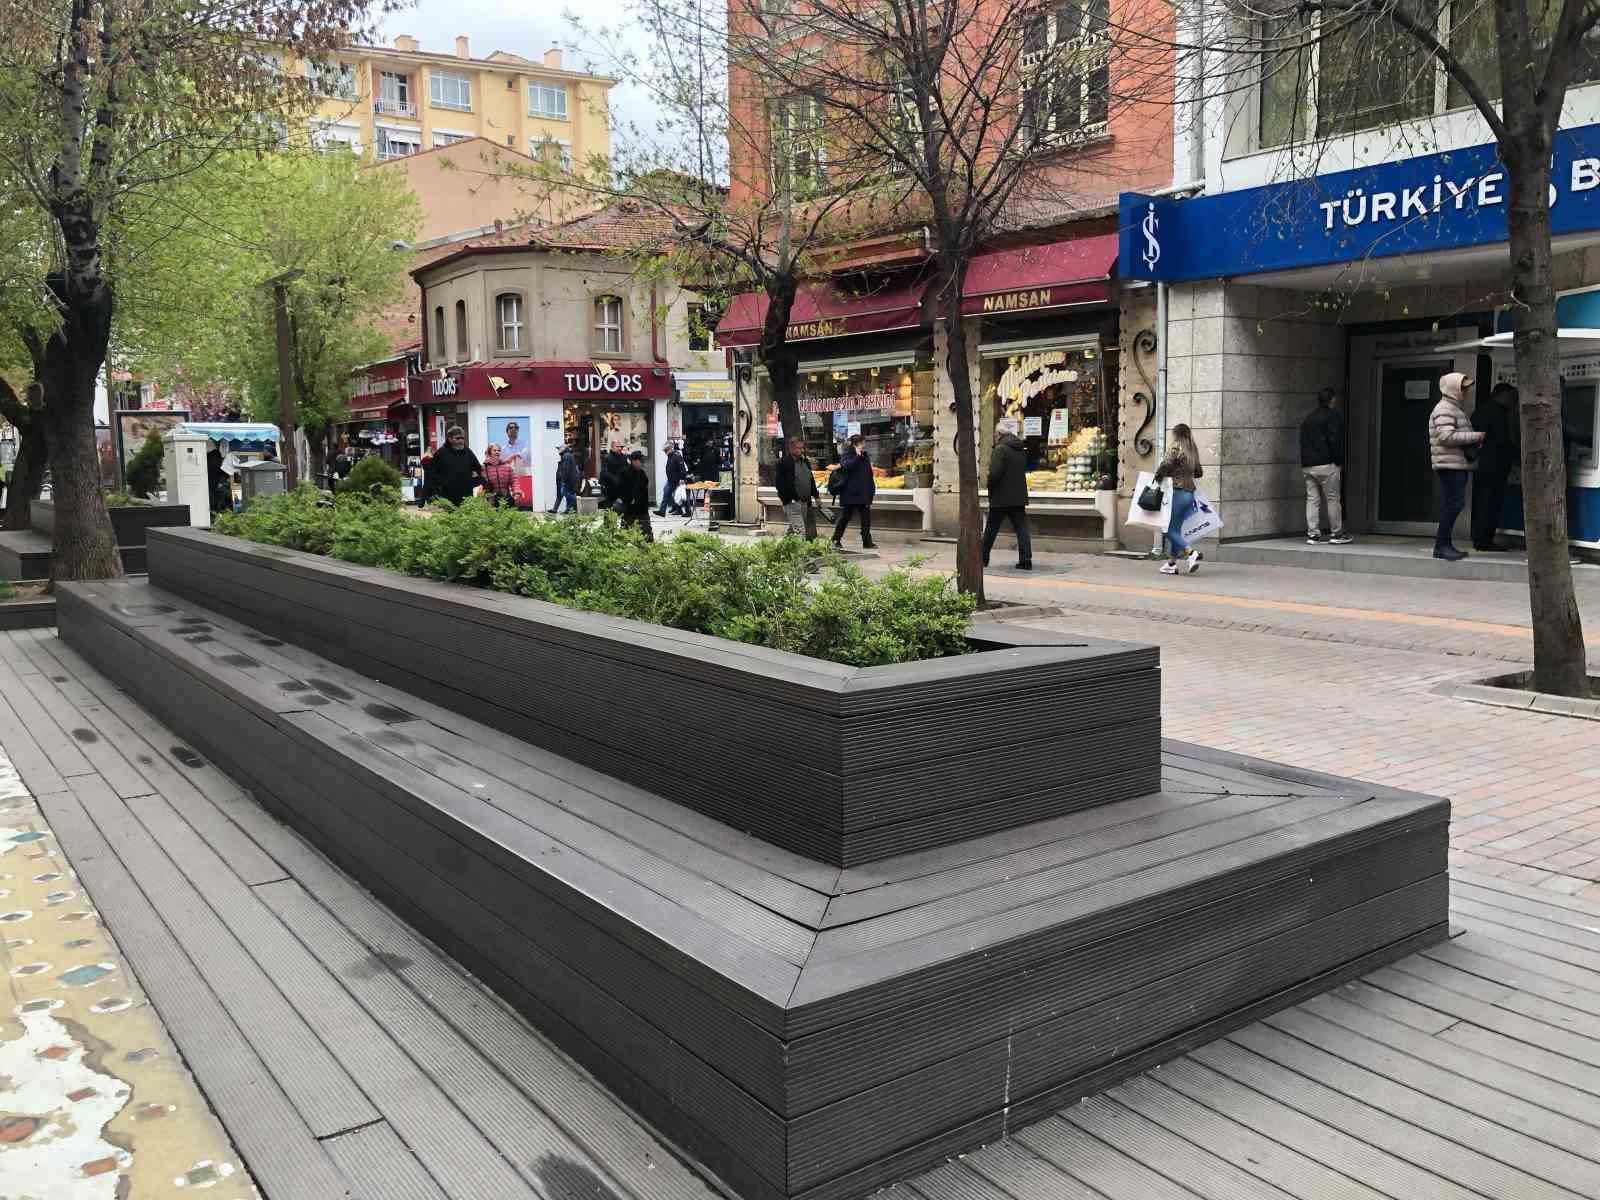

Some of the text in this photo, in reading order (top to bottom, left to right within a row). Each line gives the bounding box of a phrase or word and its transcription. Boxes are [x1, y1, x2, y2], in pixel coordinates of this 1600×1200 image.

[1319, 173, 1503, 229] TÜRKİYE
[984, 289, 1051, 312] NAMSAN
[785, 320, 833, 340] NAMSAN
[431, 376, 456, 397] TUDORS
[564, 373, 643, 393] TUDORS
